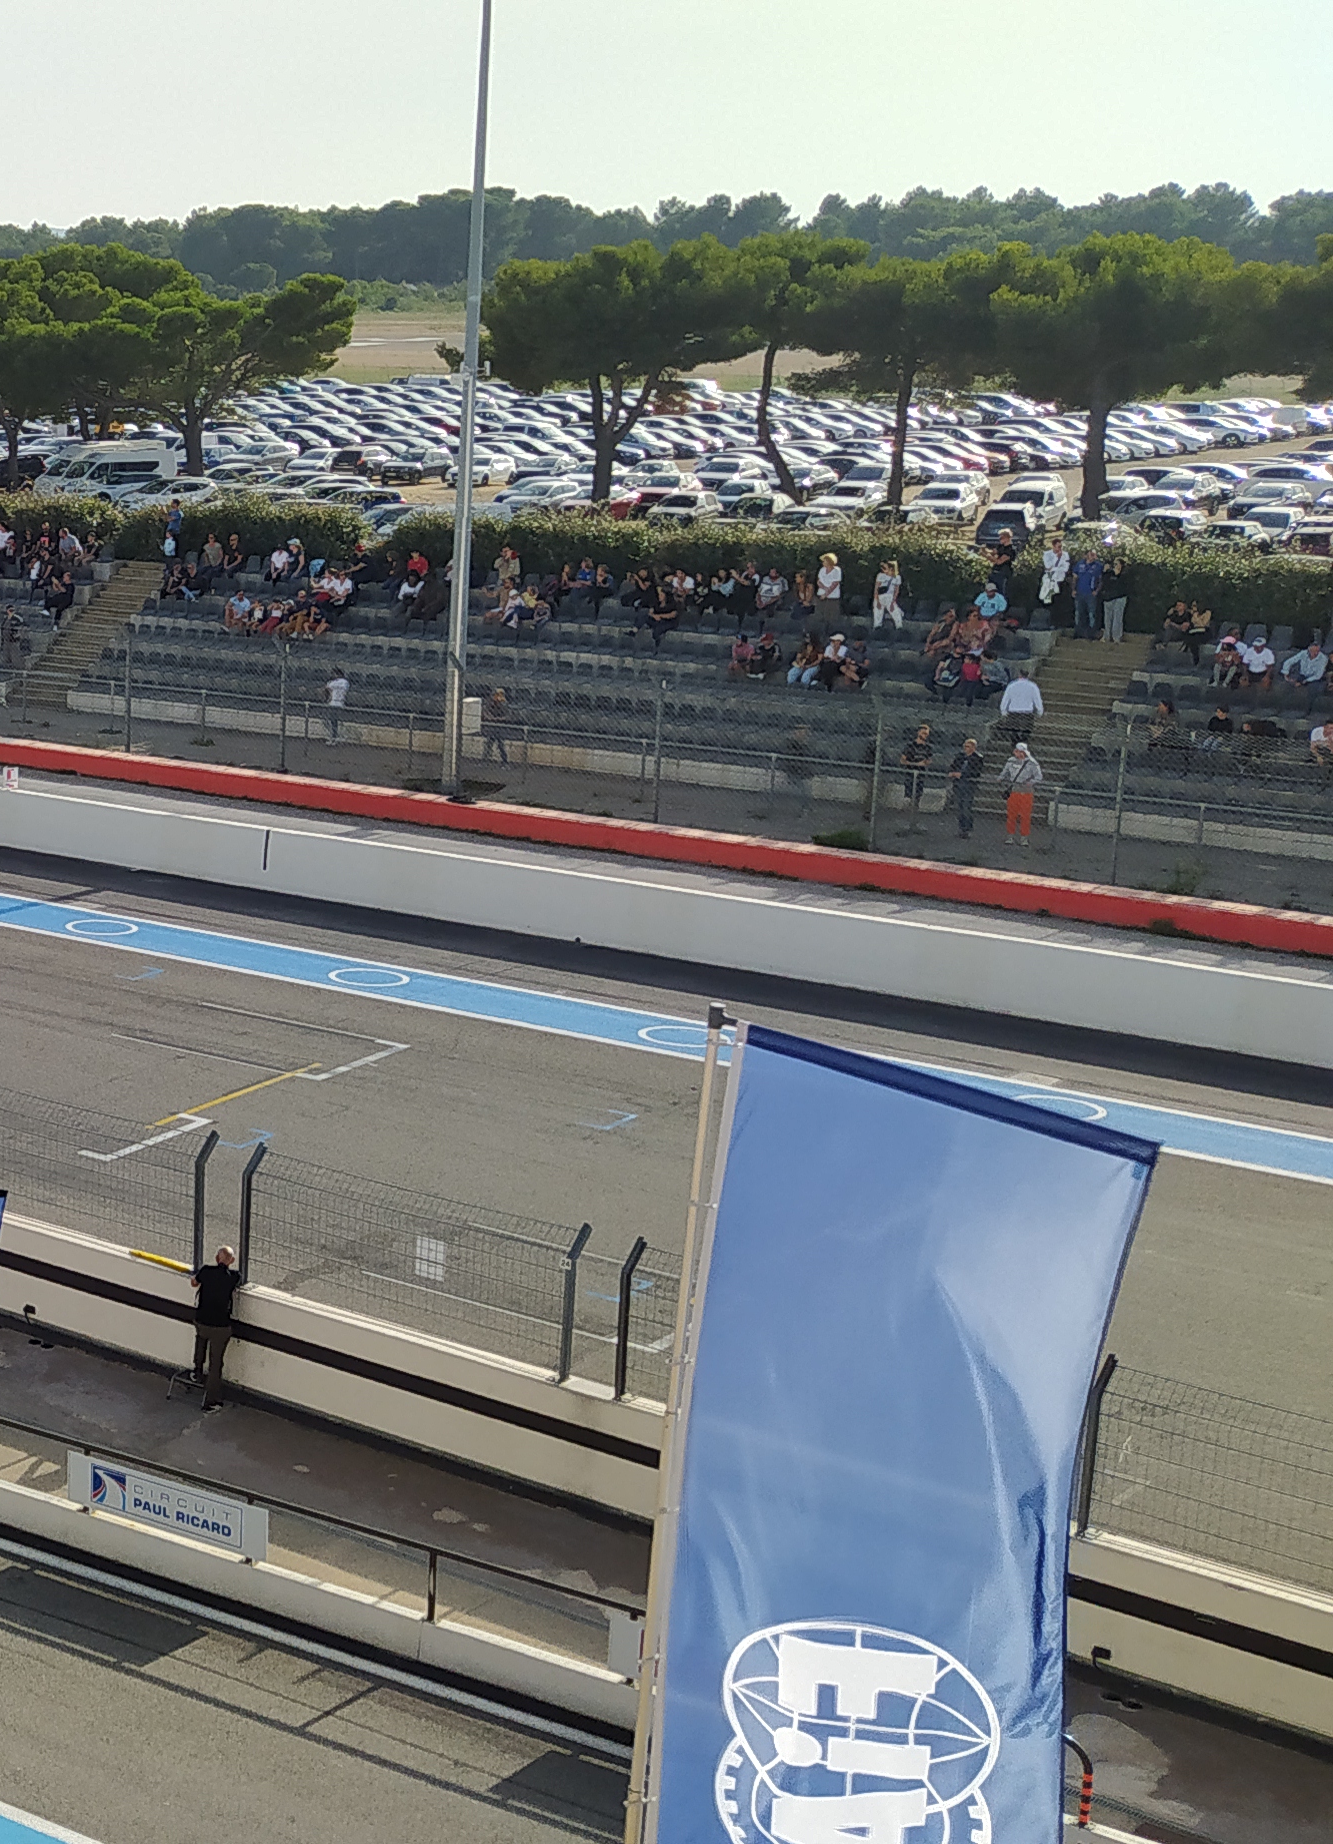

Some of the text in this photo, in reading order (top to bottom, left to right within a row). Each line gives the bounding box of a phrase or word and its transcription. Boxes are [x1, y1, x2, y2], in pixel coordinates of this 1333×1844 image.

[133, 1497, 232, 1537] PAUL RICARD
[134, 1484, 231, 1521] CIRCUIT
